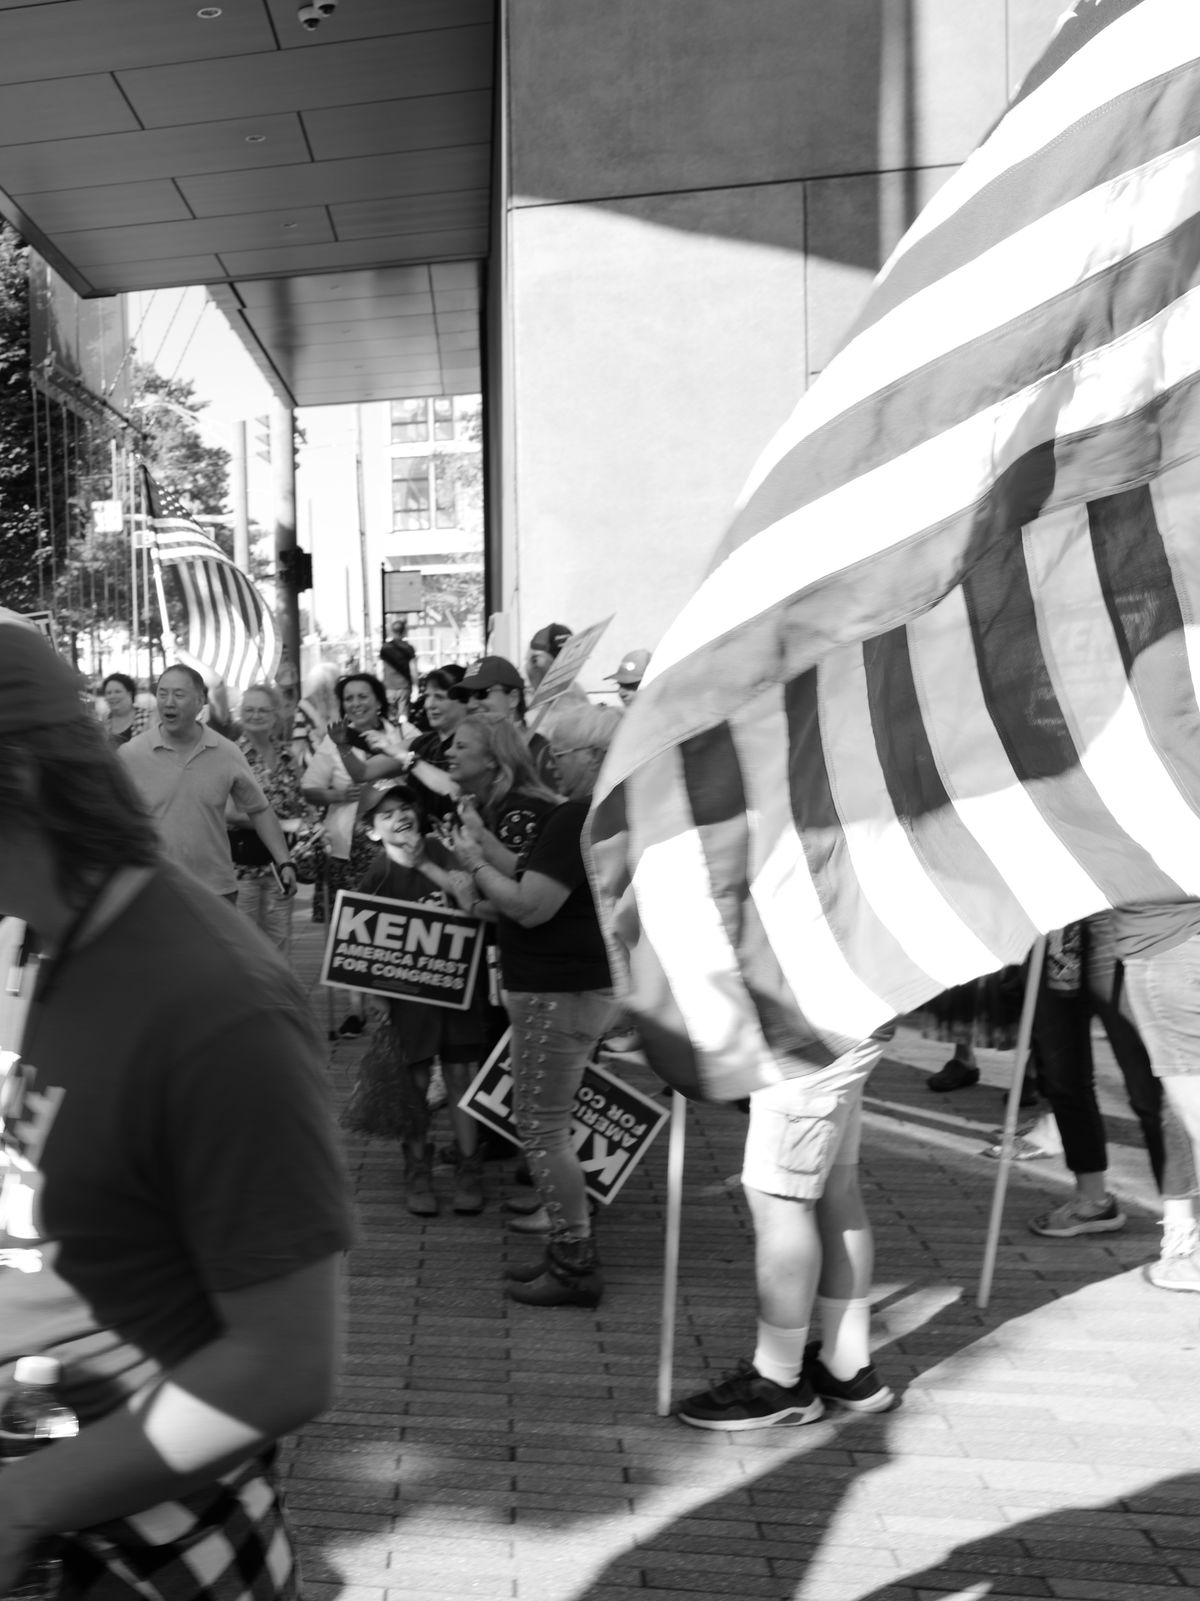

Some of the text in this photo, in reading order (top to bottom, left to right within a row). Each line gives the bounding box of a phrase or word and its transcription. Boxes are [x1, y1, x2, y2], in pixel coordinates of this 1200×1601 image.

[337, 906, 476, 960] KENT
[332, 956, 368, 973] FOR
[371, 963, 465, 990] CONGRESS
[335, 942, 468, 975] AMERICA FIRST
[606, 1104, 648, 1136] FOR
